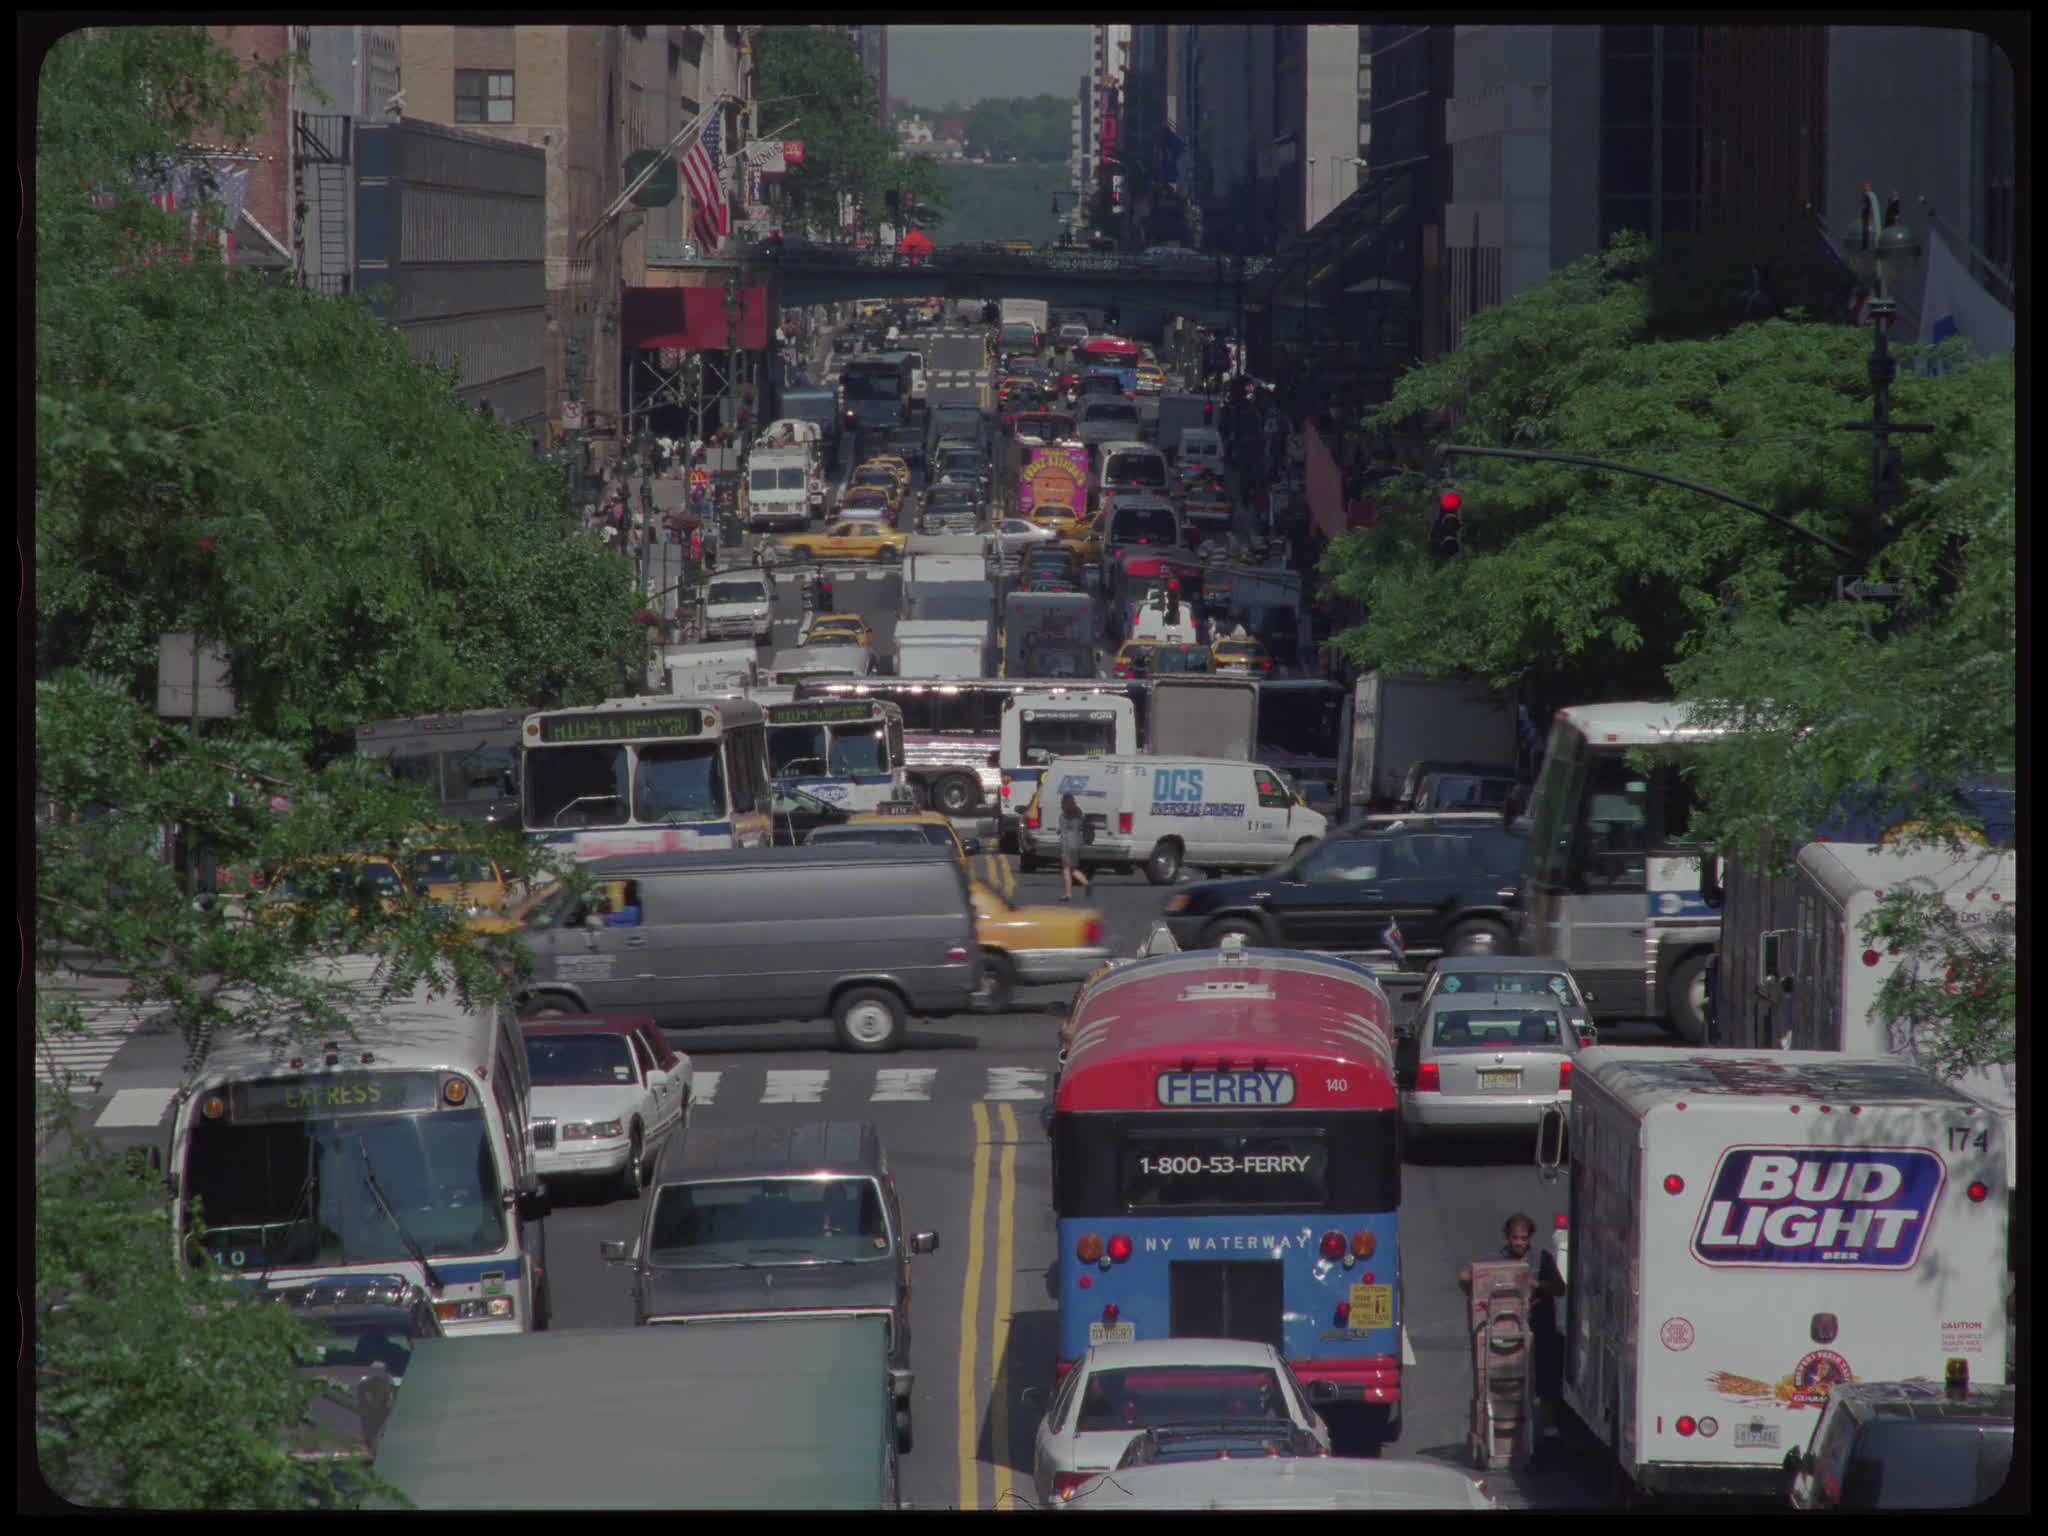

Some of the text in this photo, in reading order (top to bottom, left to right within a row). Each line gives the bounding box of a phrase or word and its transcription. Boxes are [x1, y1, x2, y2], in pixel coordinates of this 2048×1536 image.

[1167, 1073, 1285, 1104] FERRY
[1325, 1078, 1348, 1092] 140
[1947, 1127, 1989, 1152] 174
[1139, 1156, 1311, 1174] 1-800-53-FERRY
[1738, 1154, 1903, 1203] BUD
[1700, 1199, 1920, 1250] LIGHT
[1145, 1235, 1307, 1251] NY WATERWAY
